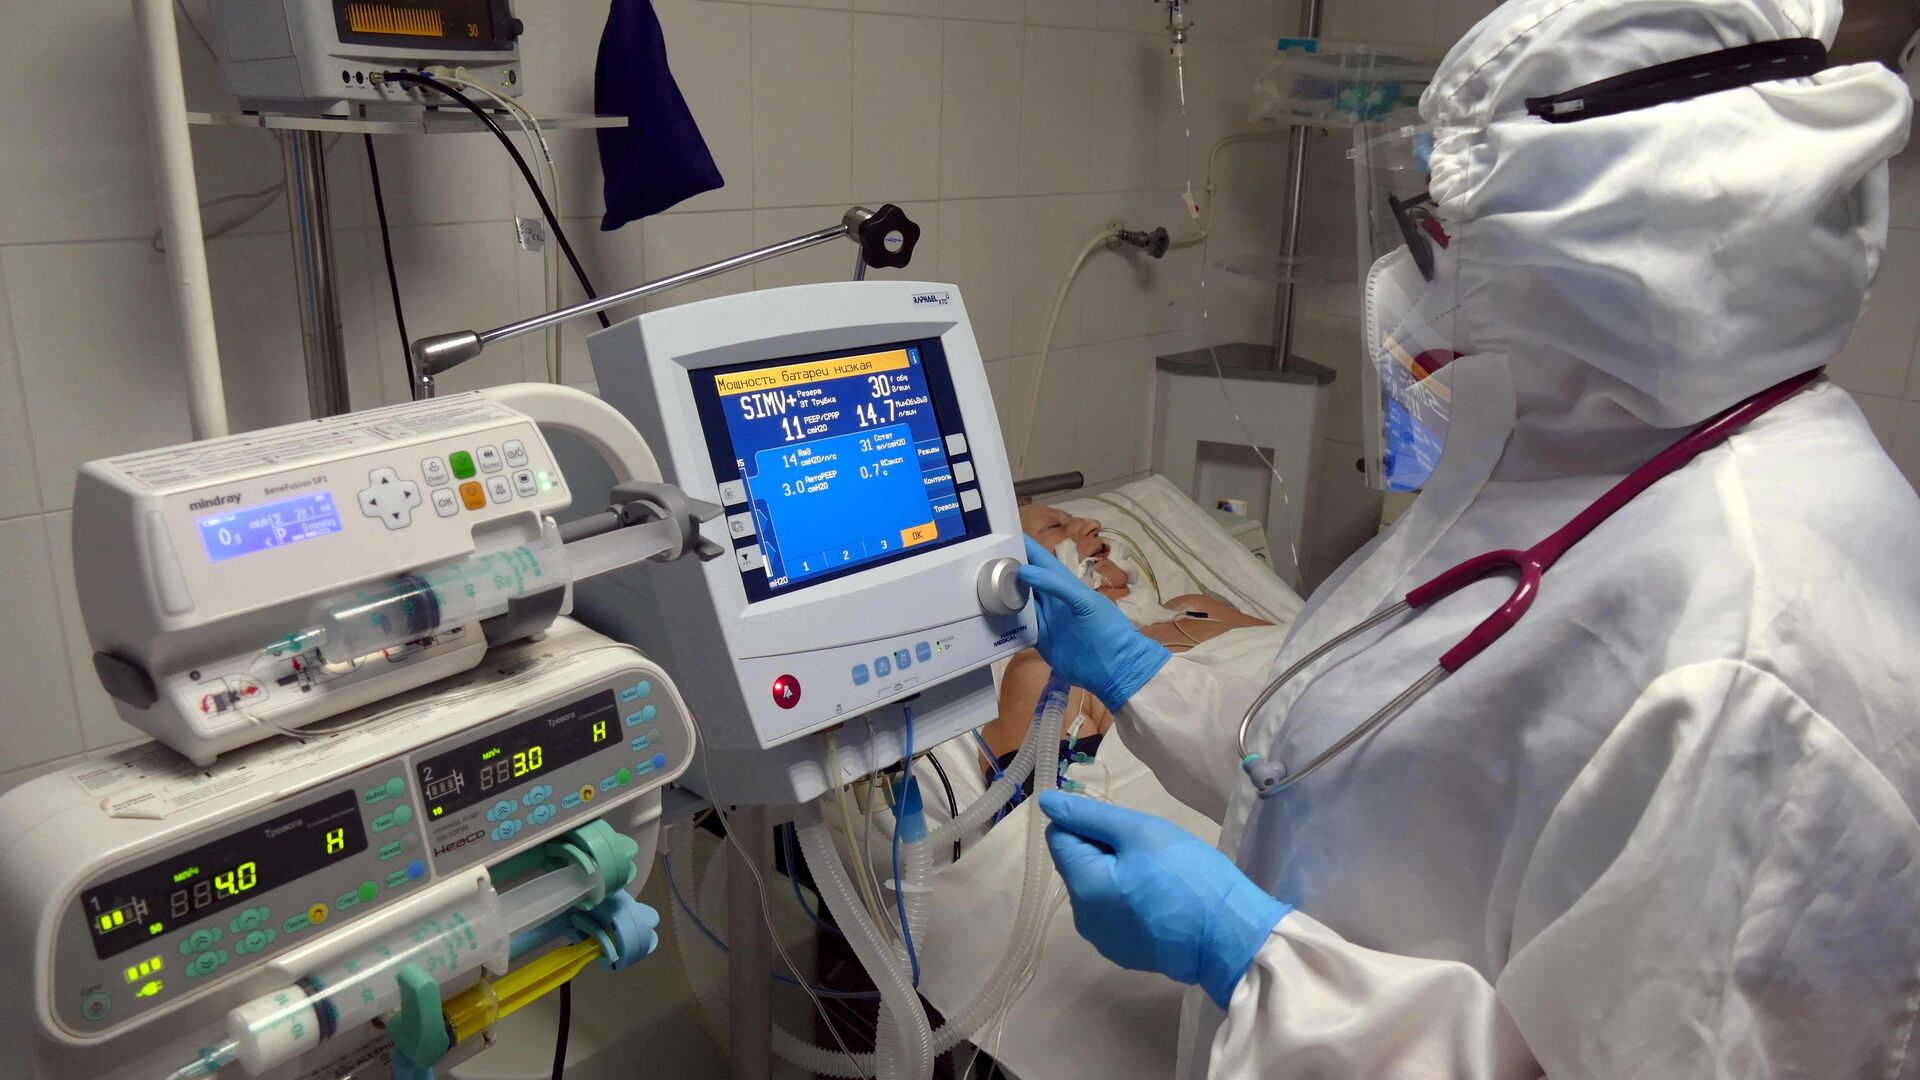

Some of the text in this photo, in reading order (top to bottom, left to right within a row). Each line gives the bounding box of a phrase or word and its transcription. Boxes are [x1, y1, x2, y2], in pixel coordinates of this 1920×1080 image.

[467, 23, 479, 37] 30
[717, 361, 873, 392] Мощность батареи низкая
[868, 374, 891, 398] 30
[740, 390, 797, 420] SIMV+
[812, 396, 837, 407] Трубка
[803, 410, 840, 424] PEEP/CPAP
[857, 399, 895, 428] 14.7
[782, 416, 806, 442] 11
[860, 438, 873, 452] 31
[782, 453, 798, 469] 14
[860, 463, 880, 479] 0.7
[923, 474, 952, 486] Контроль
[264, 481, 313, 496] BeneFusion
[782, 480, 805, 496] 3.0
[189, 493, 241, 511] mindray
[438, 496, 453, 508] OK
[933, 502, 959, 513] Тревоги
[912, 530, 923, 540] OK
[880, 540, 888, 550] 3
[842, 550, 850, 560] 2
[803, 561, 810, 572] 1
[993, 634, 1017, 647] MEDICAL
[547, 711, 576, 728] Тревога
[512, 745, 543, 778] 3.0
[423, 766, 435, 782] 2
[432, 806, 443, 817] 10
[264, 819, 304, 839] Тревога
[215, 861, 258, 895] 4.0
